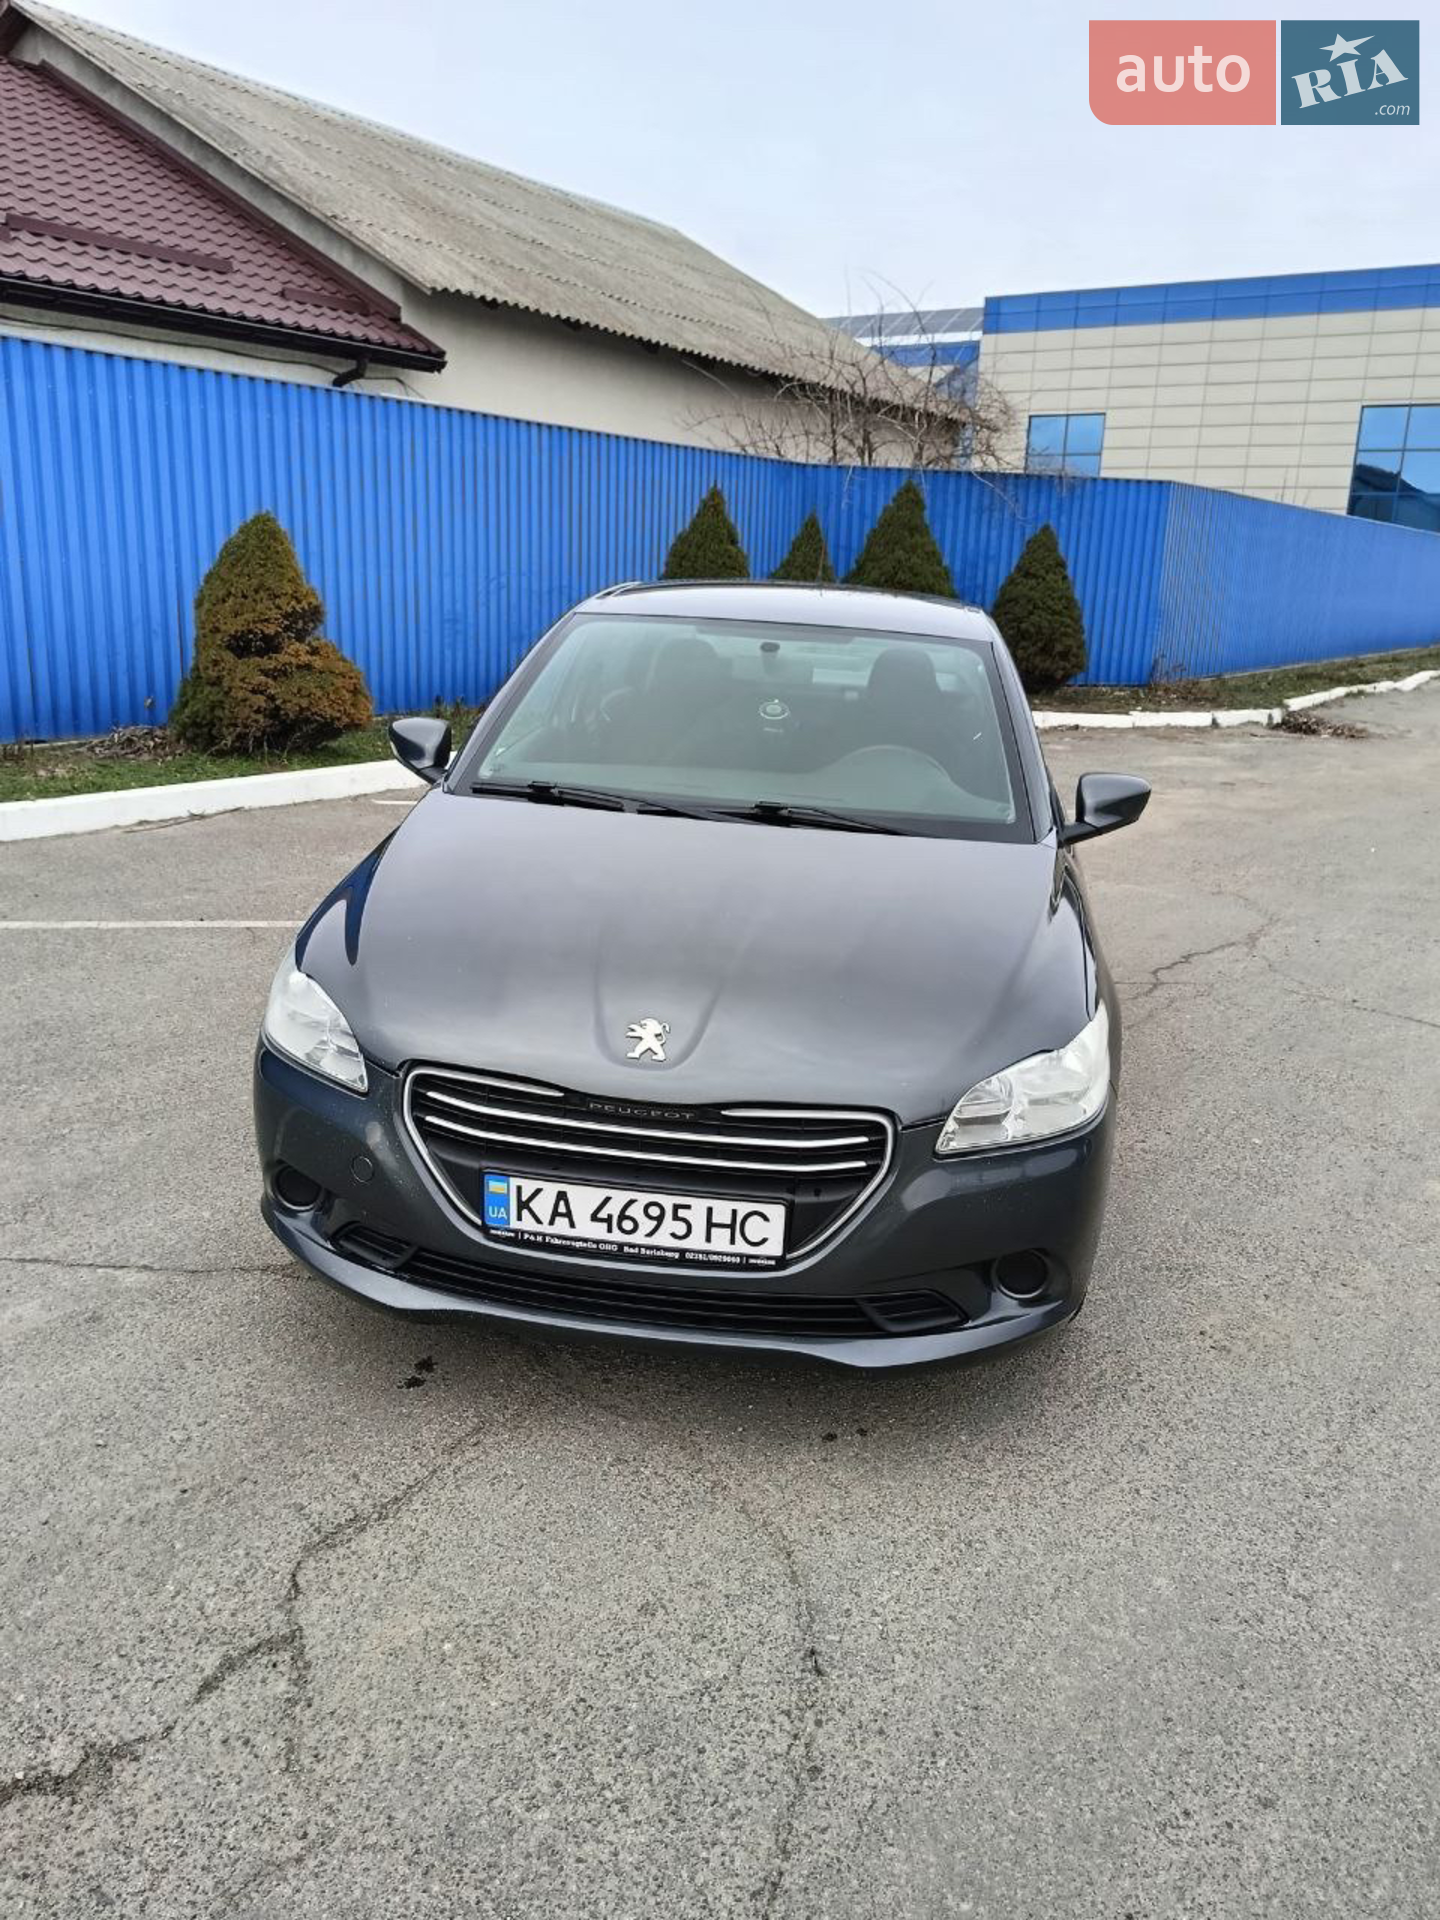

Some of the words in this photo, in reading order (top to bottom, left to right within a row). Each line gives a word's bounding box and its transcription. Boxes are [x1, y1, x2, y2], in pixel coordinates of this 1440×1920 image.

[589, 1102, 695, 1120] PEUGEOT
[488, 1205, 508, 1220] UA
[515, 1185, 577, 1229] KA
[589, 1196, 693, 1241] 4695
[704, 1206, 771, 1247] HC
